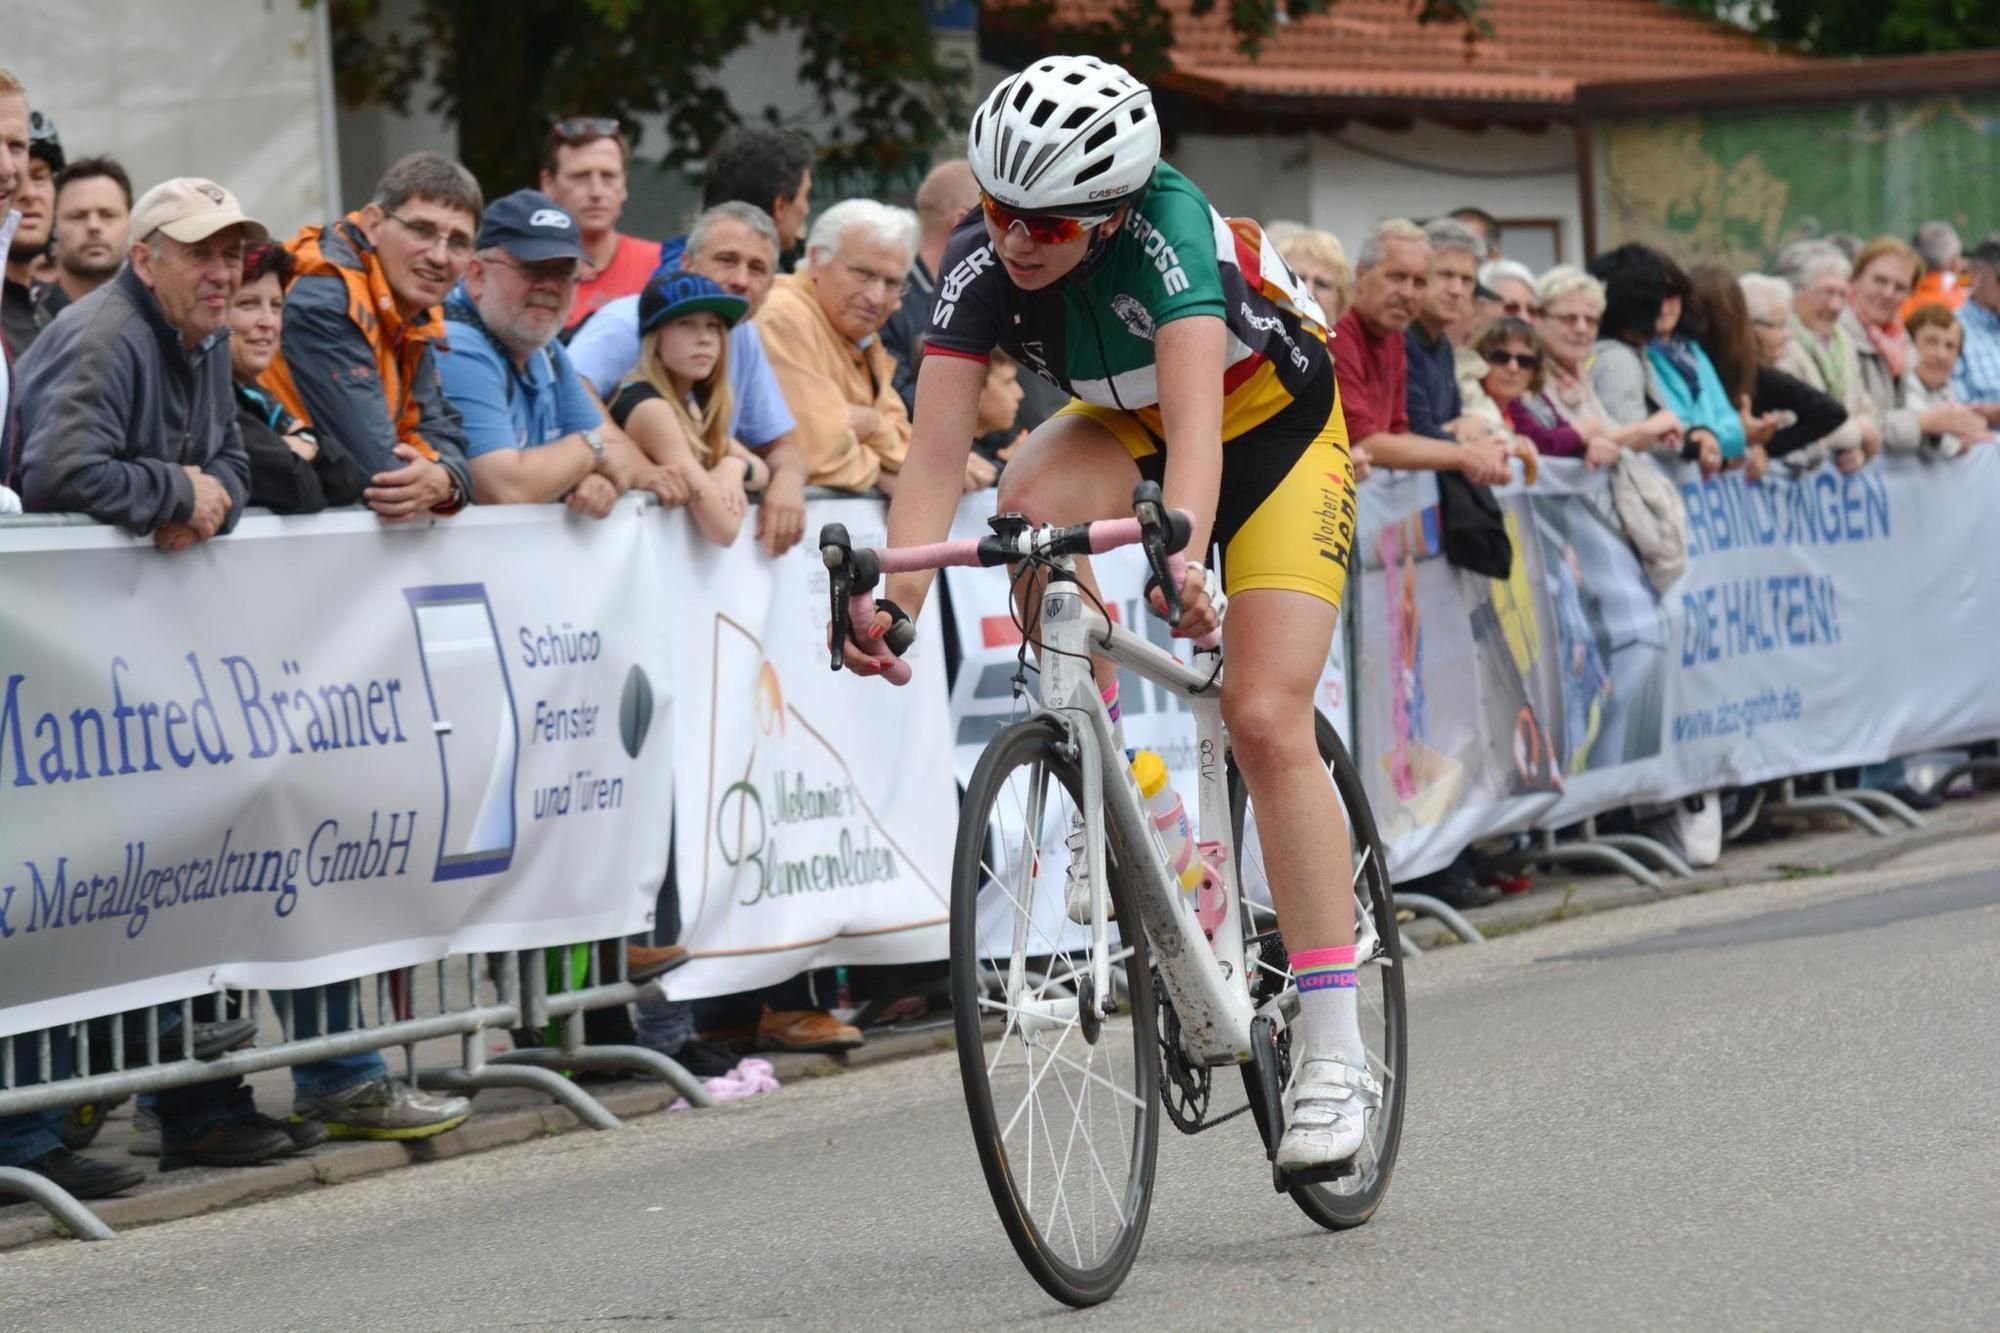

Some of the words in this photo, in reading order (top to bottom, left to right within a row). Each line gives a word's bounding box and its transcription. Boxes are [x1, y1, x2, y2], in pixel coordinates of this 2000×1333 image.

[1312, 487, 1339, 546] Norbert
[519, 623, 601, 669] Schüco
[1682, 587, 1720, 667] DIE
[1723, 574, 1841, 658] HALTEN!
[221, 655, 408, 760] Brämer
[532, 699, 600, 745] Fenster
[533, 777, 571, 821] und
[24, 829, 302, 939] Metallgestaltung
[306, 810, 418, 888] GmbH
